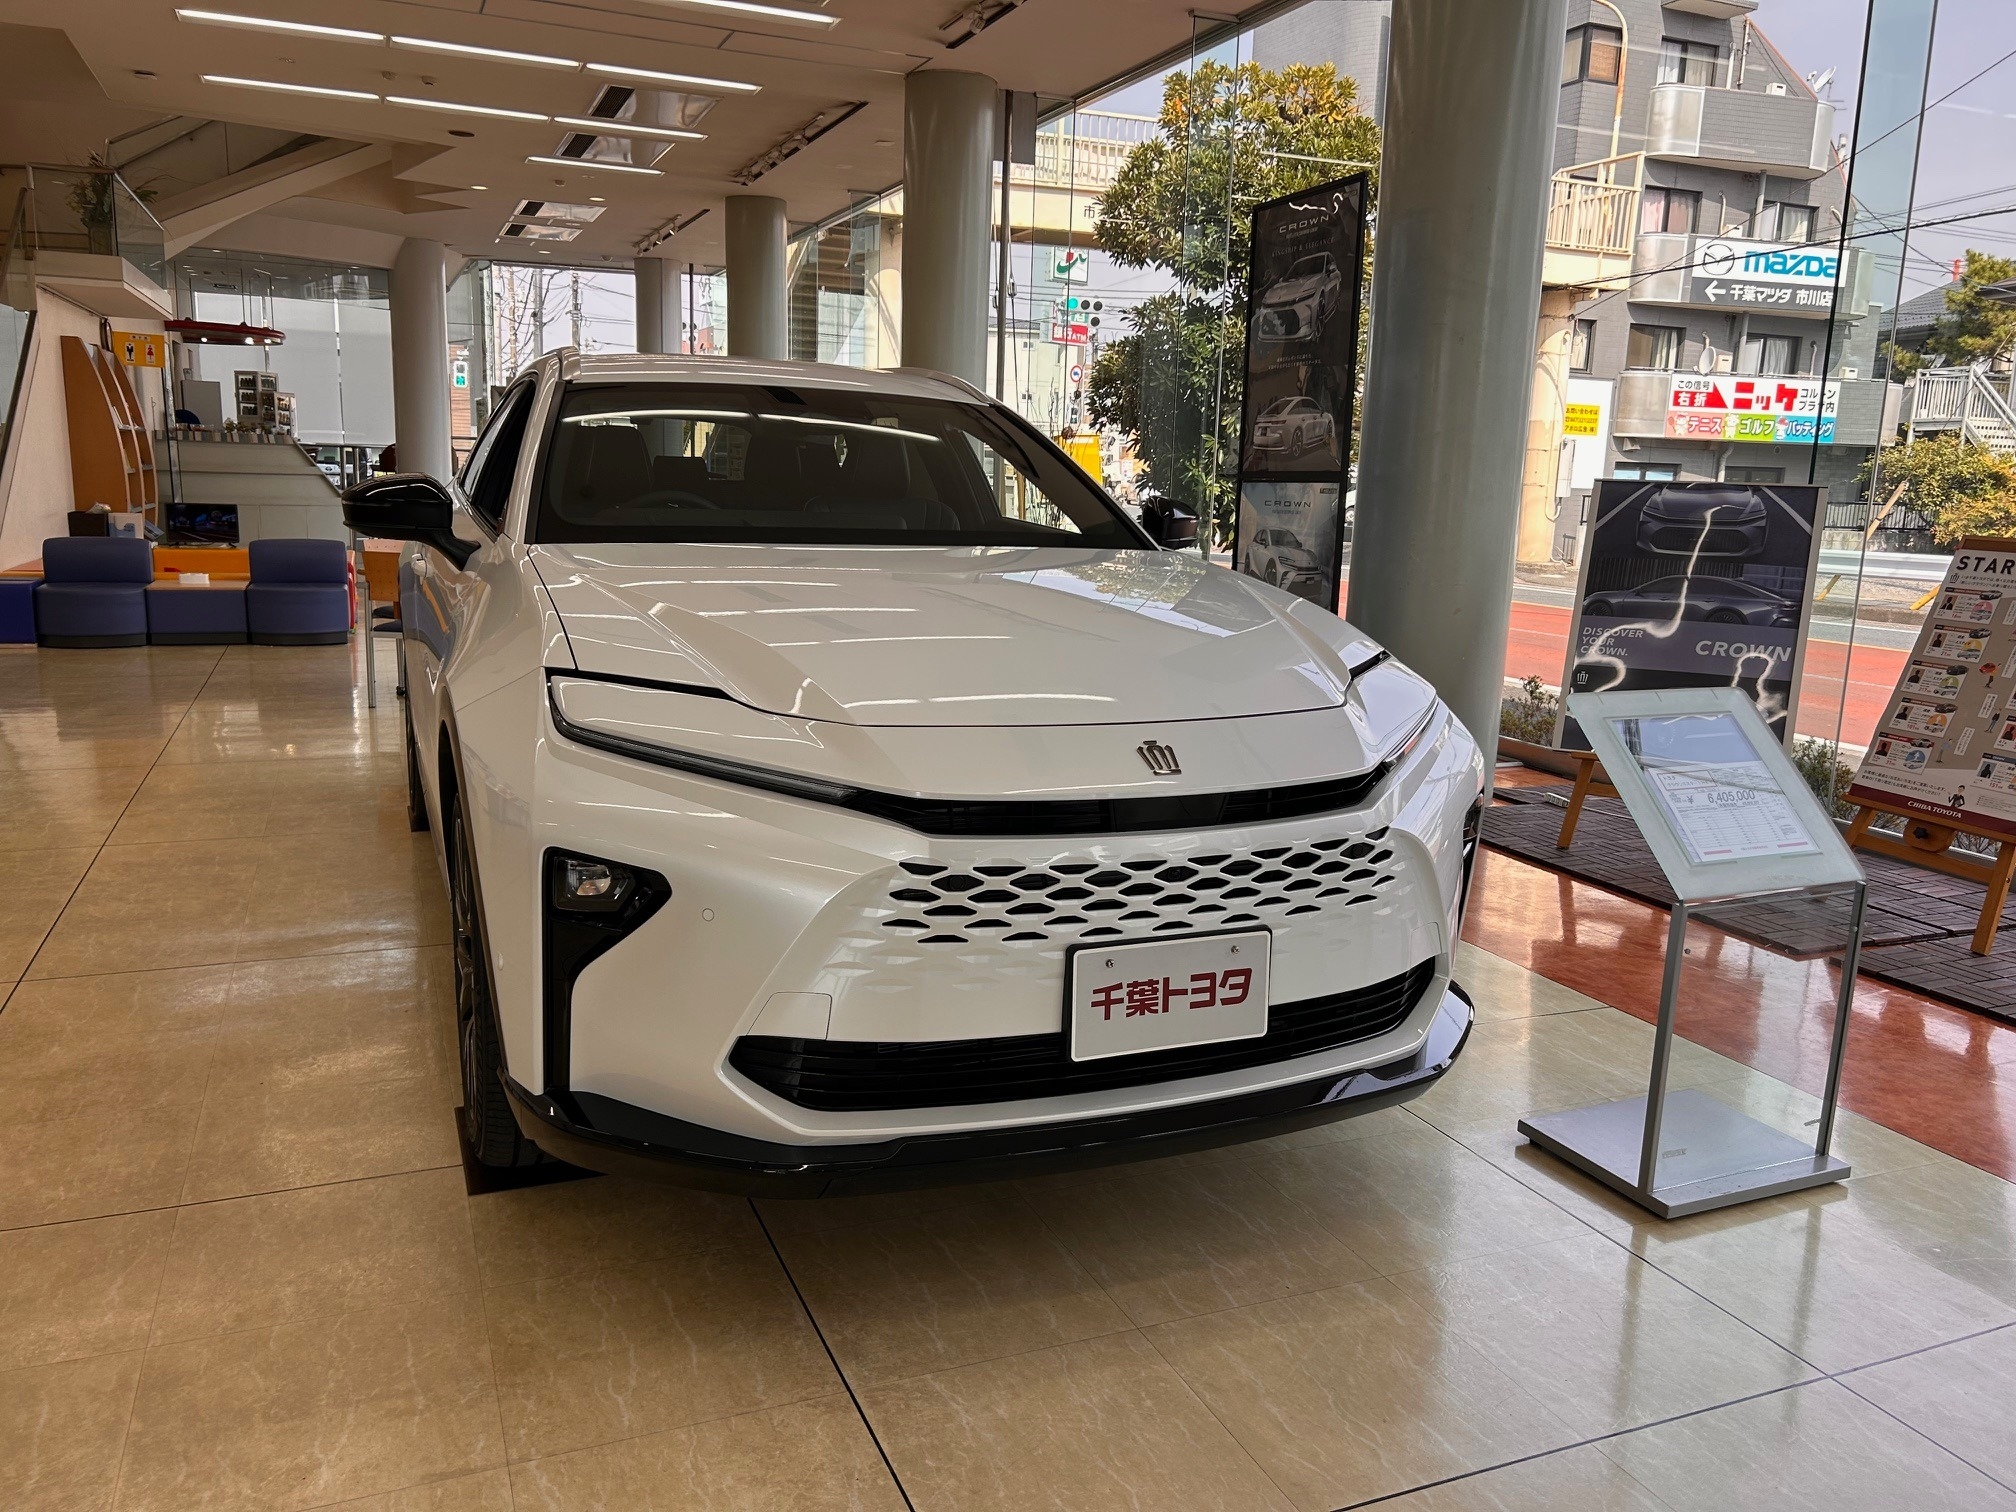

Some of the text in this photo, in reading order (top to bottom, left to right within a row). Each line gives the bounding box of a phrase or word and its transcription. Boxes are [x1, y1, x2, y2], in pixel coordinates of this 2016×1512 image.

[1083, 205, 1096, 219] 市
[1280, 214, 1329, 233] CROWN
[1729, 283, 1834, 307] 千葉マツダ 市川店
[1677, 379, 1710, 391] この信号
[1677, 391, 1708, 407] 右折
[1732, 381, 1799, 412] ニッケ
[1800, 388, 1837, 400] コルン
[1798, 400, 1835, 413] プラ内
[1687, 416, 1723, 433] テニス
[1739, 418, 1775, 435] ゴルフ
[1264, 500, 1312, 508] CROWN
[1956, 555, 2016, 575] STAR
[1582, 626, 1644, 638] DISCOVER
[1581, 636, 1615, 646] YOUR
[1580, 645, 1629, 657] CROWN.
[1695, 639, 1792, 663] CROWN
[1707, 788, 1756, 804] 6,405,000
[1907, 800, 1962, 819] CHIBA TOYOTA
[1090, 967, 1253, 1021] 千葉トヨタ
